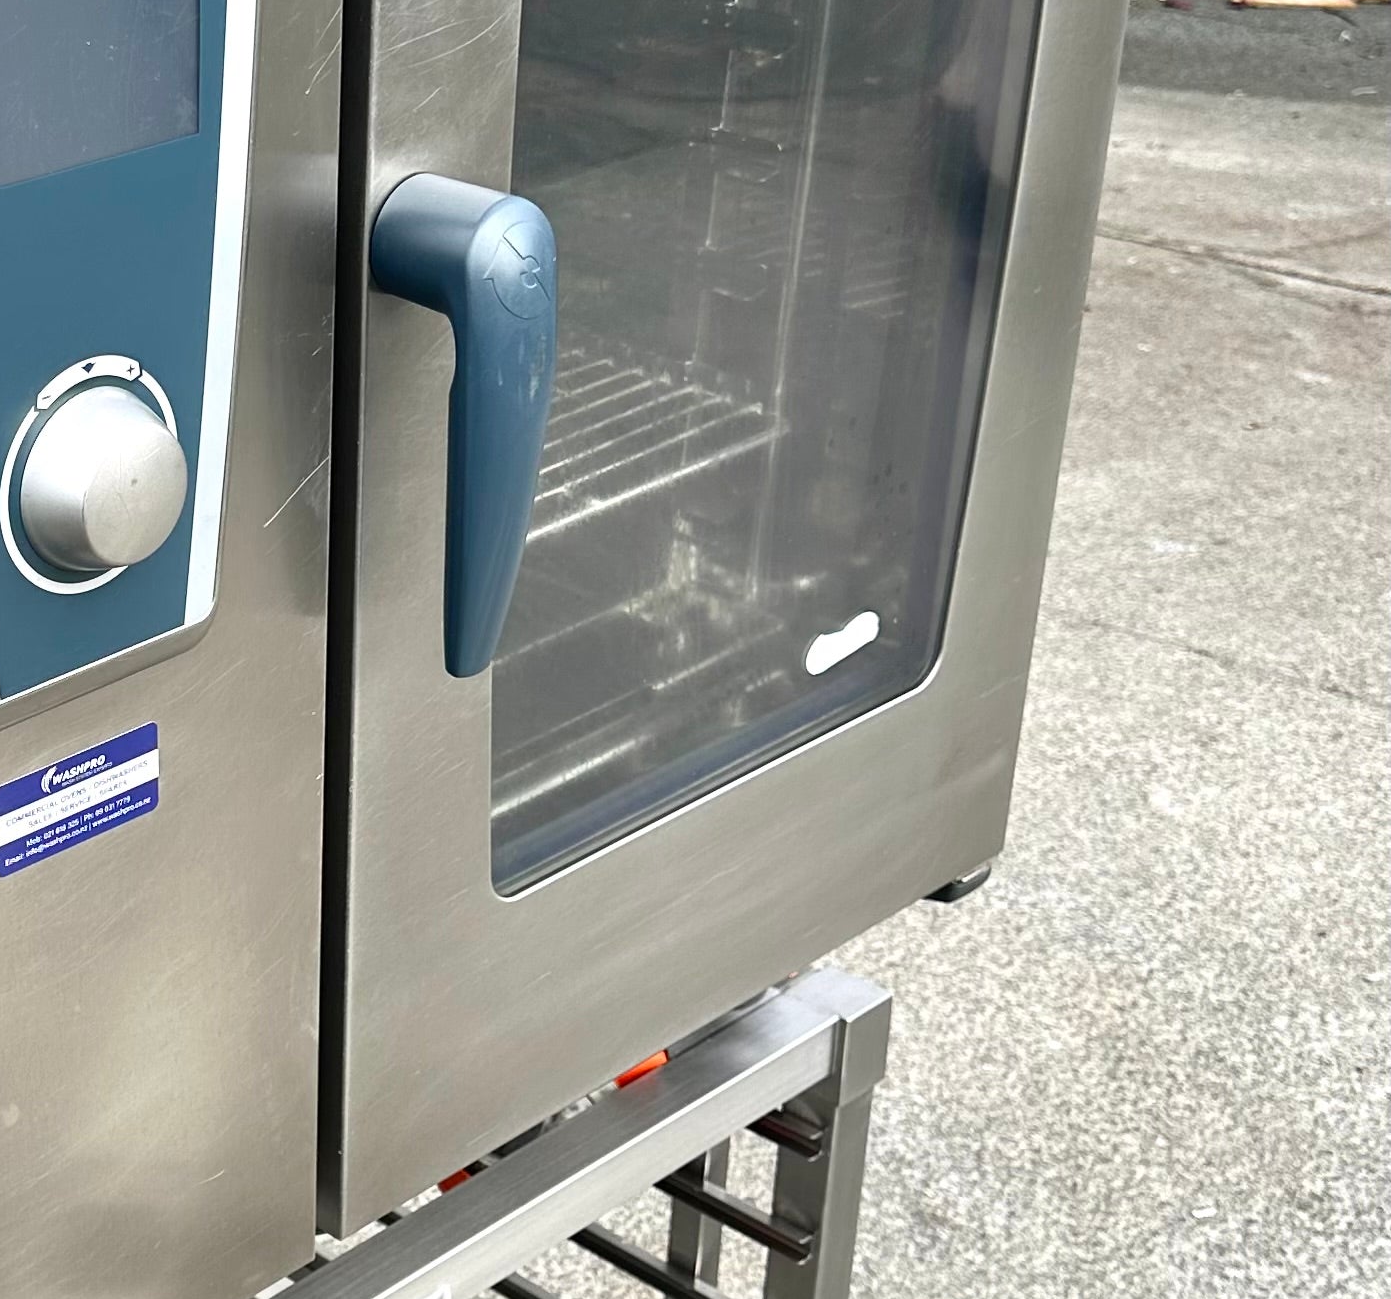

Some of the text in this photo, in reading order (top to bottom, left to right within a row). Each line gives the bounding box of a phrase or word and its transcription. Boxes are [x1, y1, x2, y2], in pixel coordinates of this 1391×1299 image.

[6, 759, 147, 828] COMMERCIAL OVENS DISHWASHERS
[53, 753, 105, 786] WASHPRO
